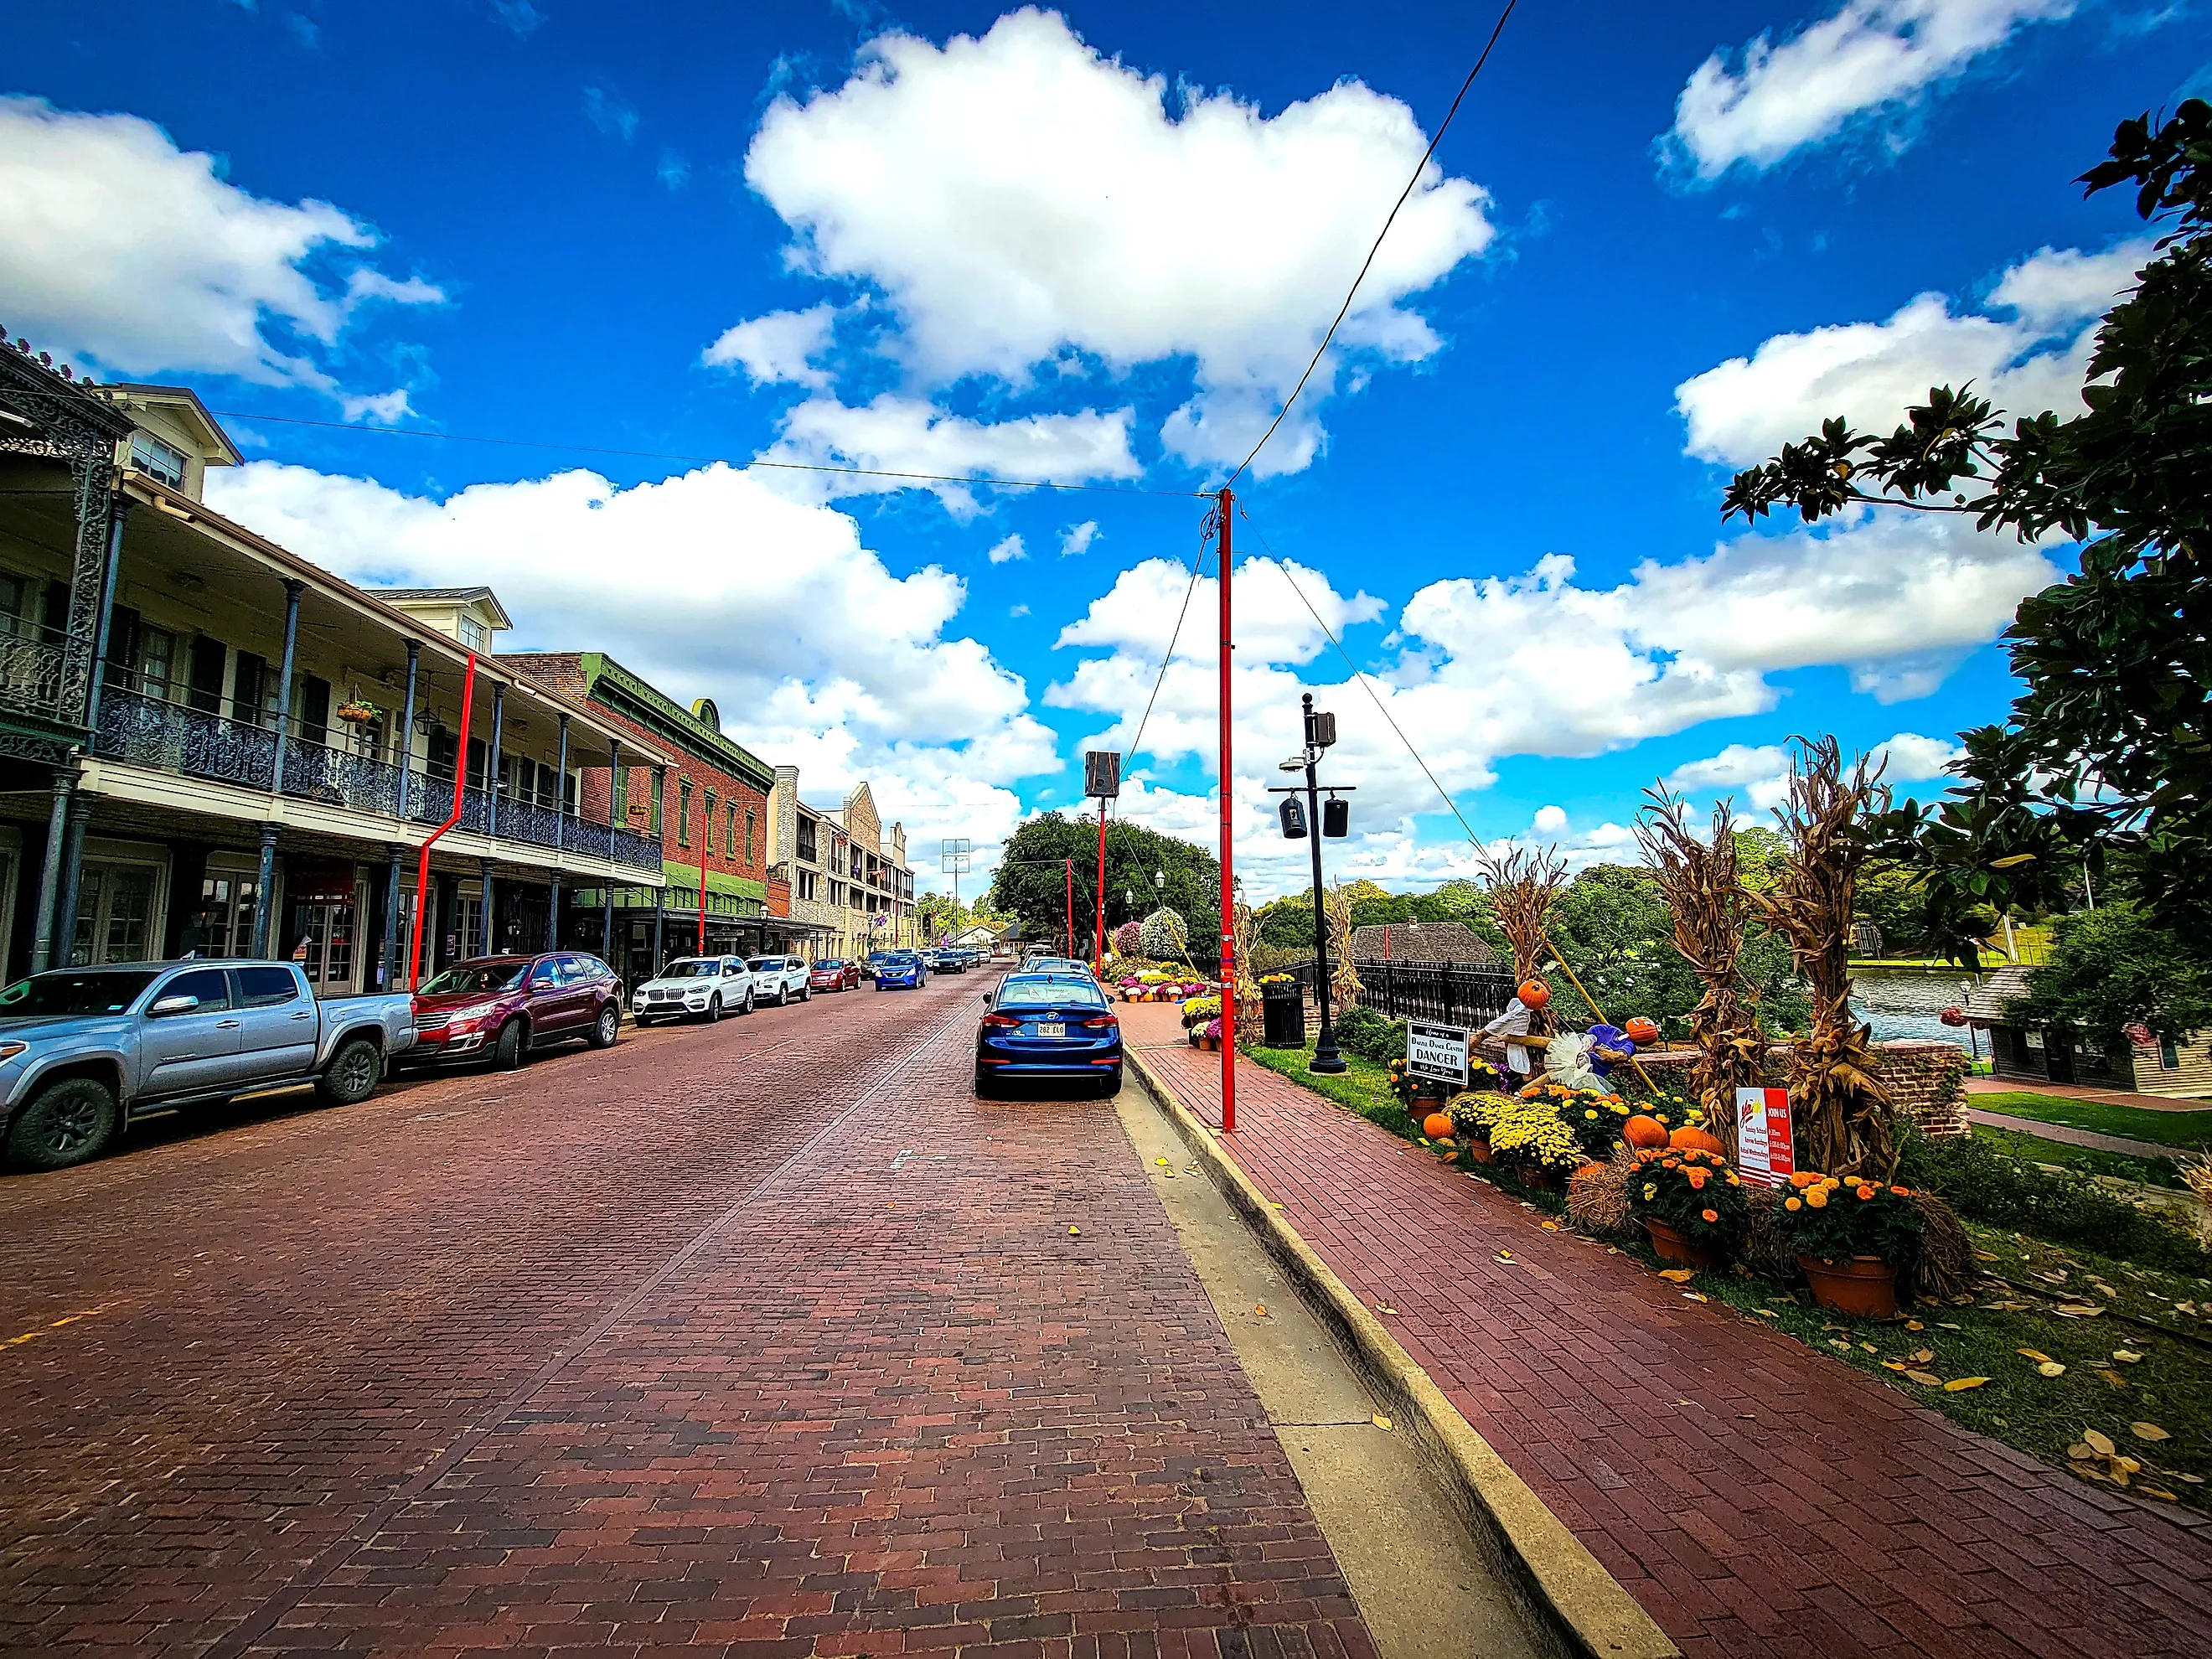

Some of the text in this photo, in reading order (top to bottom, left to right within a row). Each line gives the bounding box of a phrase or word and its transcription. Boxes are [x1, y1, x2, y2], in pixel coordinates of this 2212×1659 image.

[1416, 1049, 1457, 1066] DANCER
[1441, 1067, 1453, 1077] You!
[1768, 1108, 1787, 1118] JOIN US
